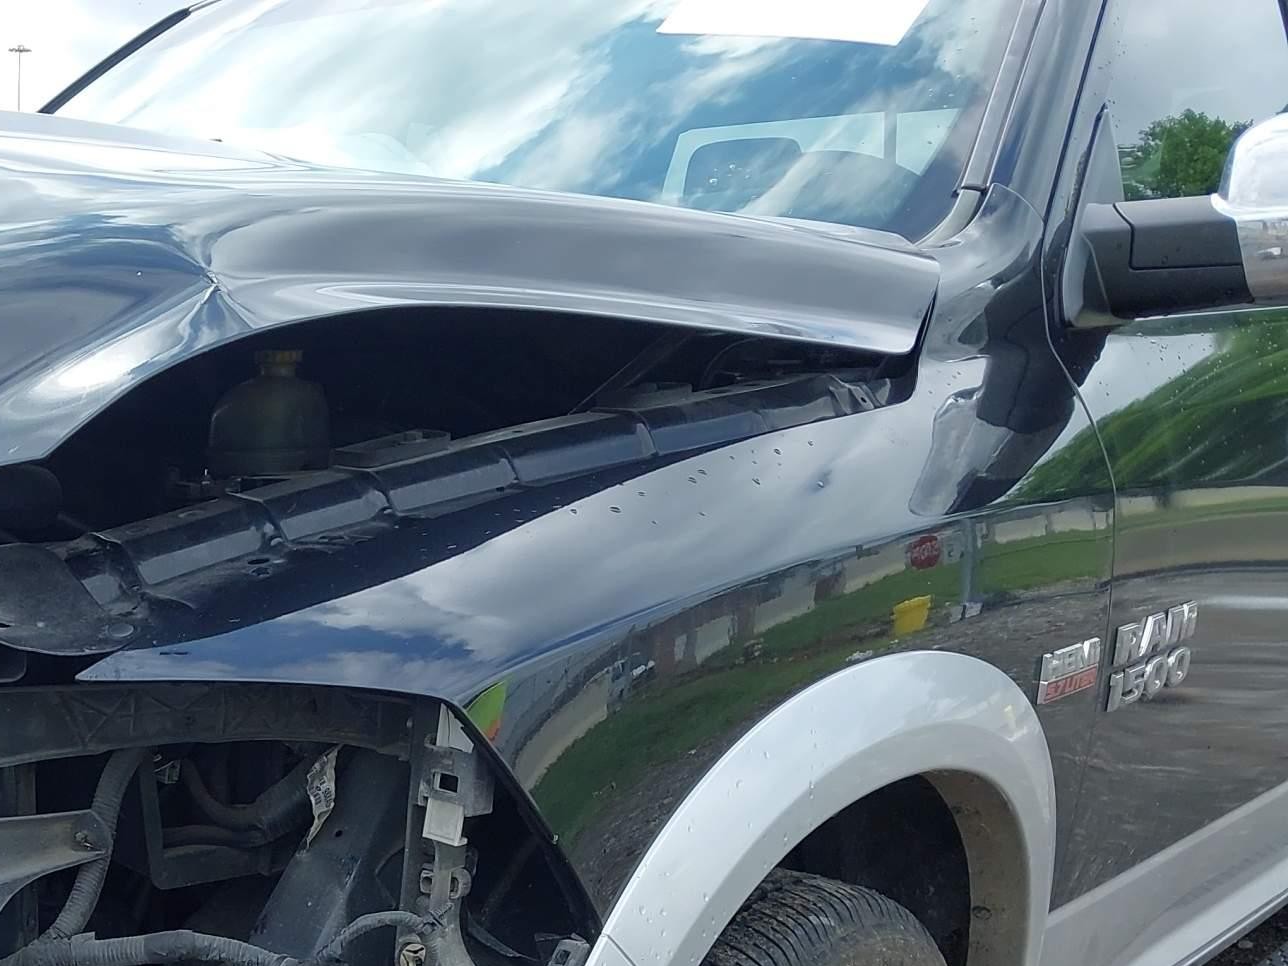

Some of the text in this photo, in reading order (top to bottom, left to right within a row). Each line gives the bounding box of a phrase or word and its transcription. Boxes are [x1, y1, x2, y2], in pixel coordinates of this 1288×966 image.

[1041, 637, 1100, 682] HEMI
[1113, 600, 1197, 666] RAM
[1107, 647, 1191, 712] 1500
